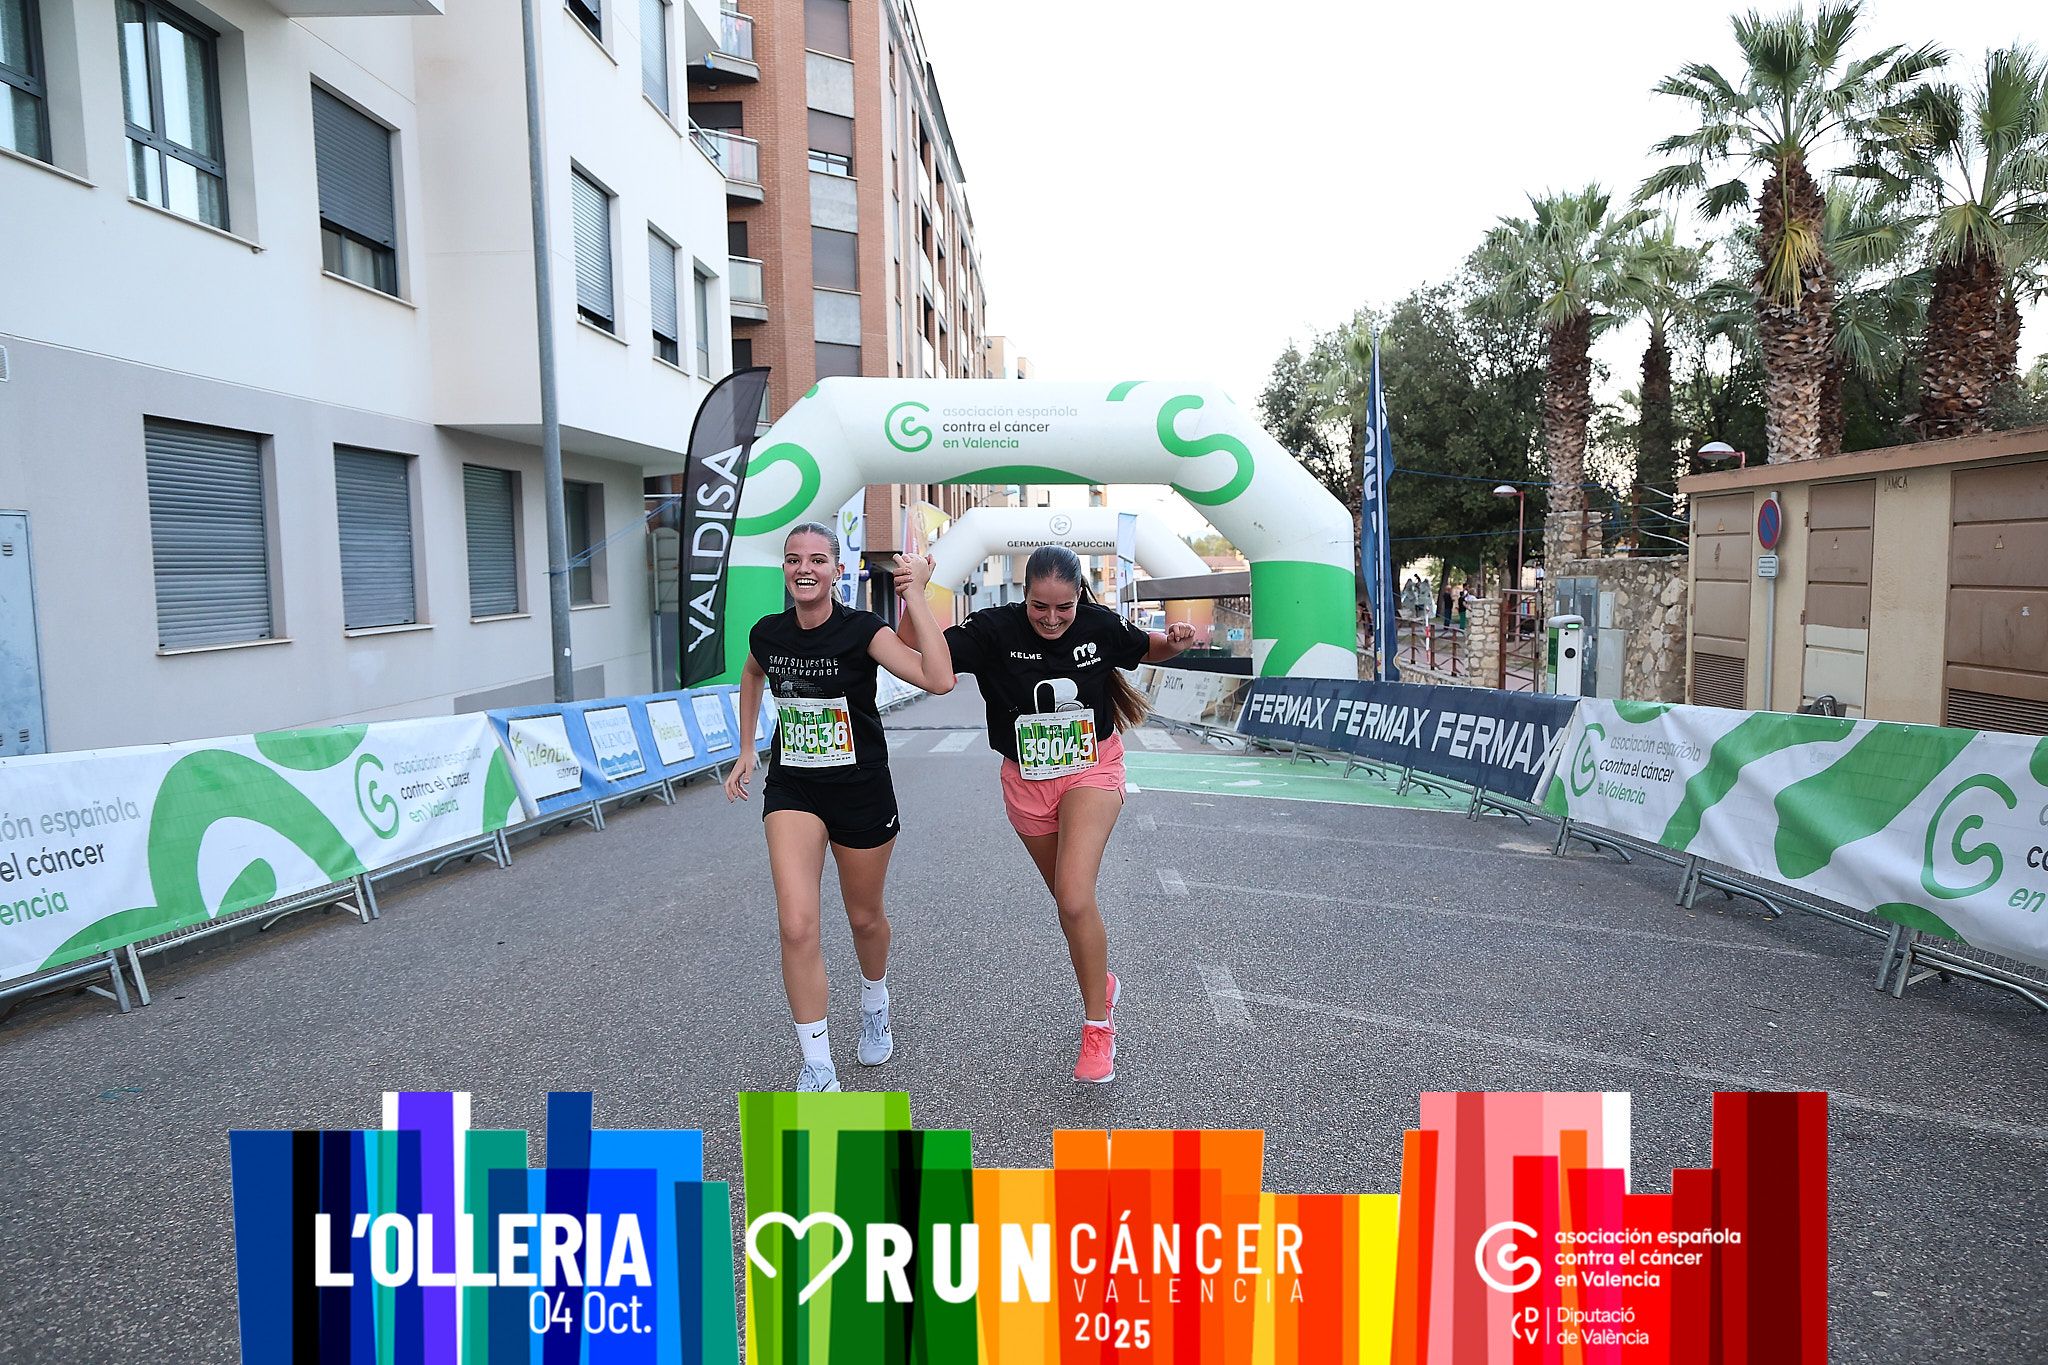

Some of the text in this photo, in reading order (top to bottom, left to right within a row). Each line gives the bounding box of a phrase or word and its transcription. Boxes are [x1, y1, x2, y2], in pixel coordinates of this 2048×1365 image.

[942, 405, 1078, 419] asociación española
[942, 420, 1050, 433] contra el cáncer
[942, 437, 1019, 449] en Valencia
[687, 444, 743, 653] VALDISA
[1064, 540, 1115, 548] CAPUCCINI
[768, 655, 839, 668] SANT SILVESTRE
[1010, 651, 1043, 660] KELME
[768, 666, 839, 676] montaverner
[784, 721, 849, 749] 38536
[1248, 693, 1566, 776] FERMAX FERMAX FERMAX
[1610, 733, 1655, 754] asociación
[1022, 733, 1094, 762] 39043
[1599, 758, 1675, 783] contra el cáncer
[400, 780, 435, 800] contra
[433, 776, 448, 791] el
[1604, 780, 1646, 805] Valencia
[0, 797, 141, 842] ón española
[408, 809, 428, 823] en
[26, 843, 105, 877] cáncer
[0, 887, 70, 926] encia
[2007, 887, 2046, 913] en
